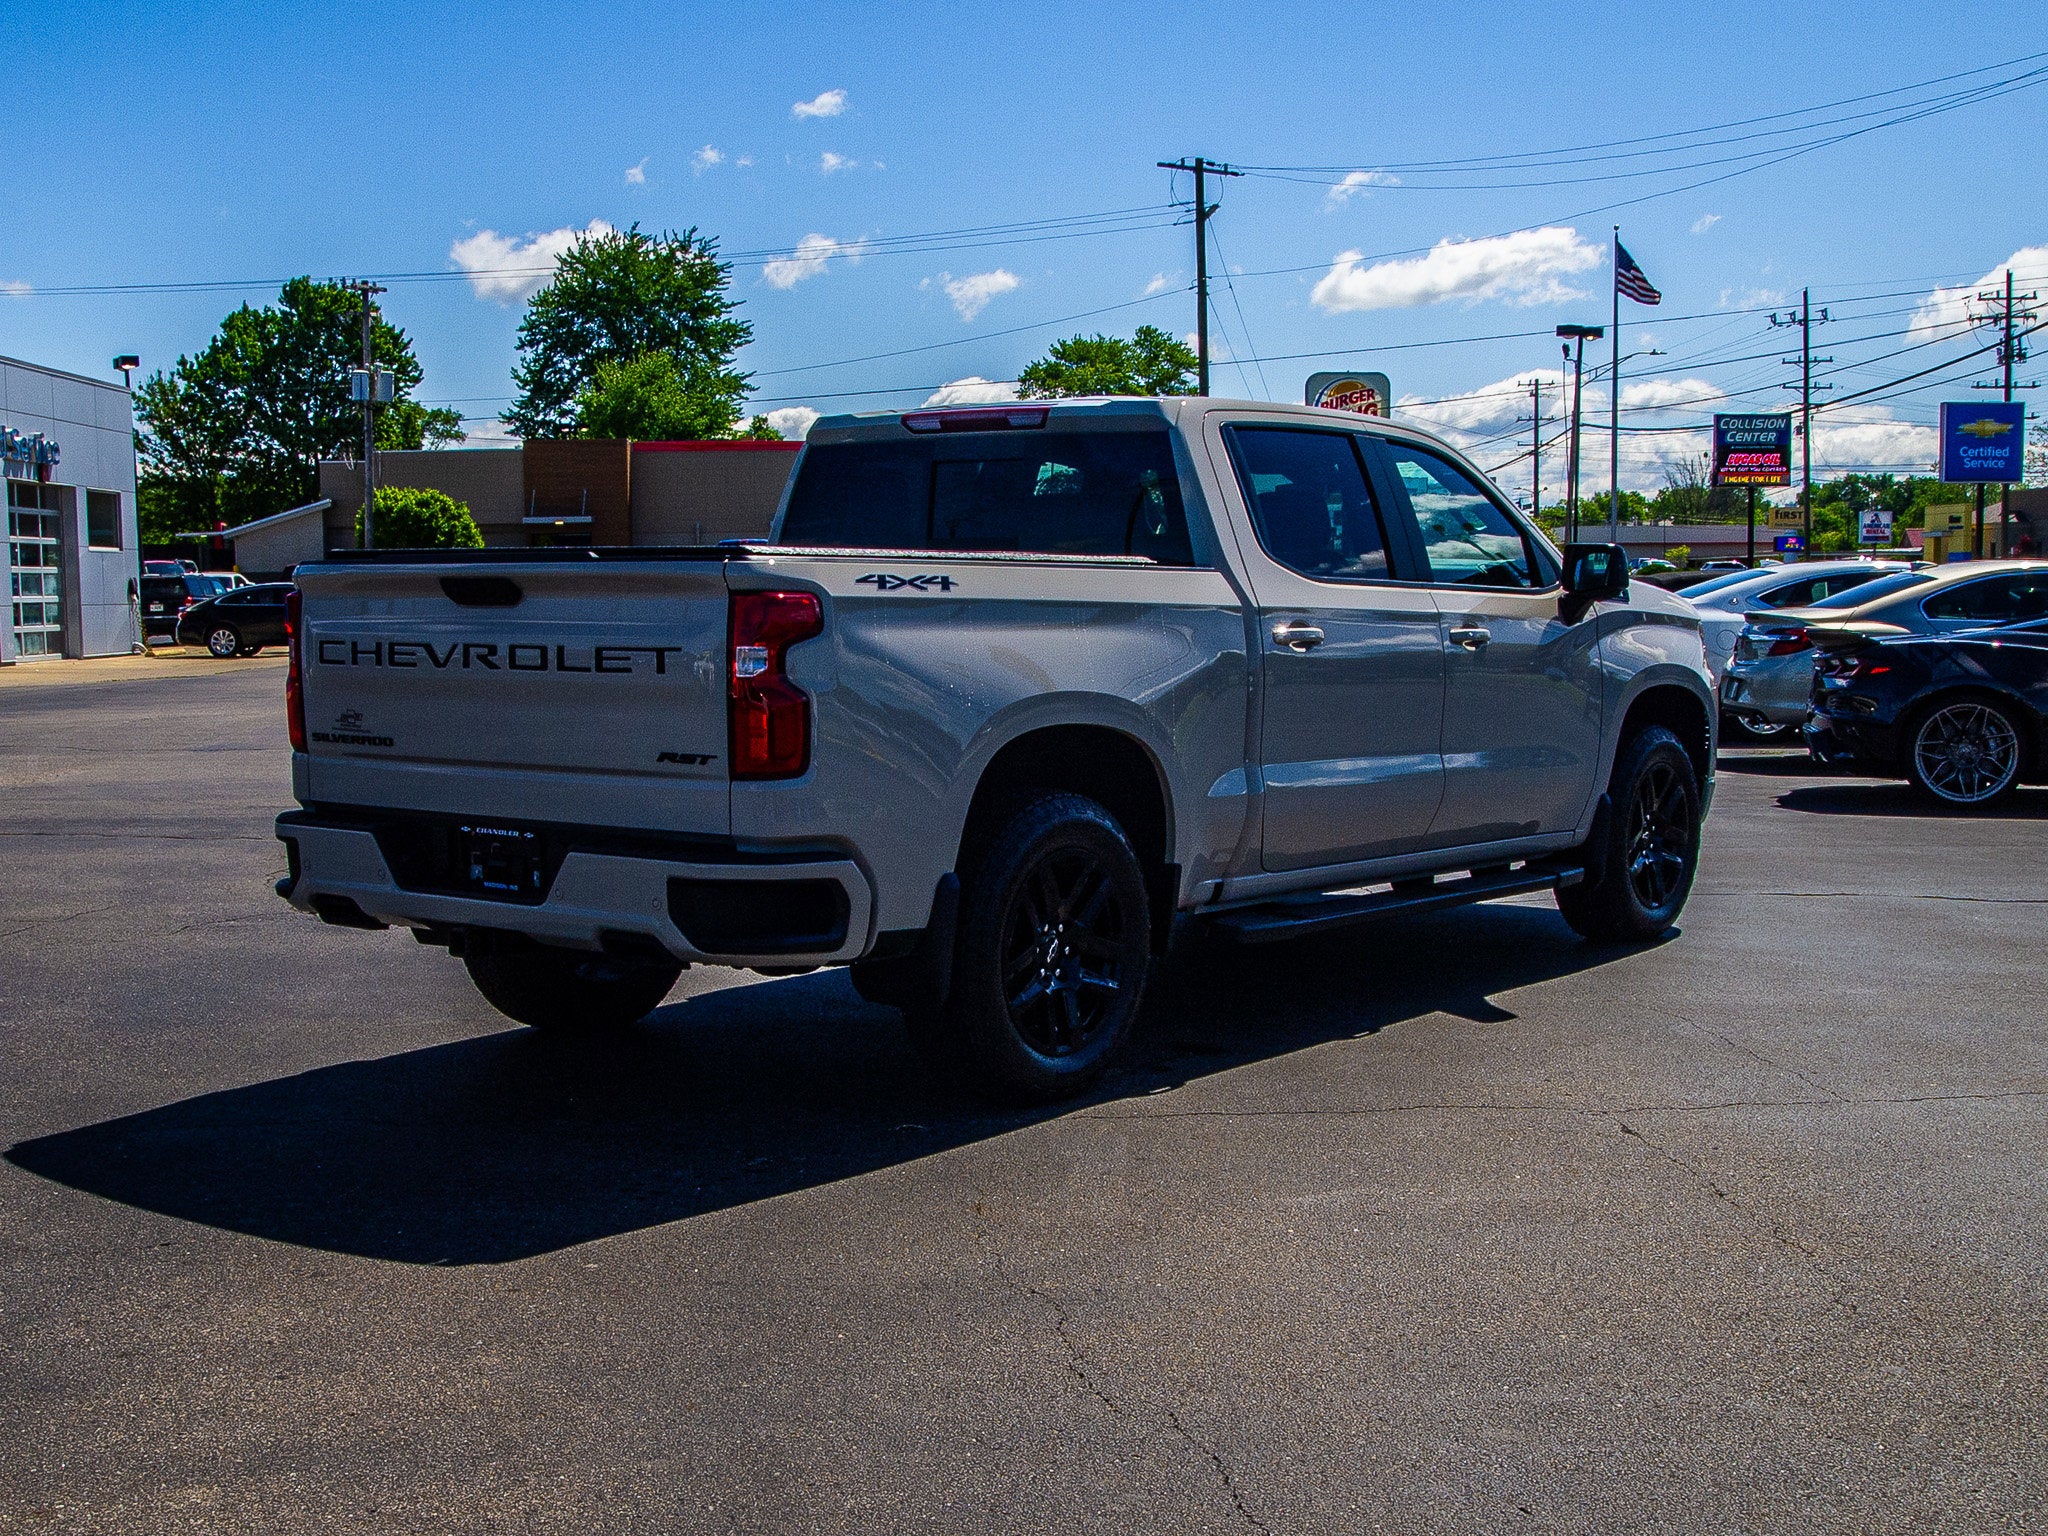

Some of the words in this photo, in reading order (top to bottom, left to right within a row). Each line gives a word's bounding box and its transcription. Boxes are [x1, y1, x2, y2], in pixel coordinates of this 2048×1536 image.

[1321, 388, 1375, 409] BURGER
[1720, 418, 1786, 429] COLLISION
[1726, 431, 1777, 442] CENTER
[1960, 447, 2009, 457] Certified
[1726, 453, 1762, 466] LUCAS
[1762, 453, 1781, 466] OIL
[1964, 458, 2005, 468] Service
[1724, 475, 1749, 483] ENGINE
[1775, 510, 1803, 519] FIRST
[318, 639, 683, 675] CHEVROLET
[312, 732, 394, 747] SILVERADO
[656, 752, 718, 766] RST
[476, 828, 519, 836] CHANDLER
